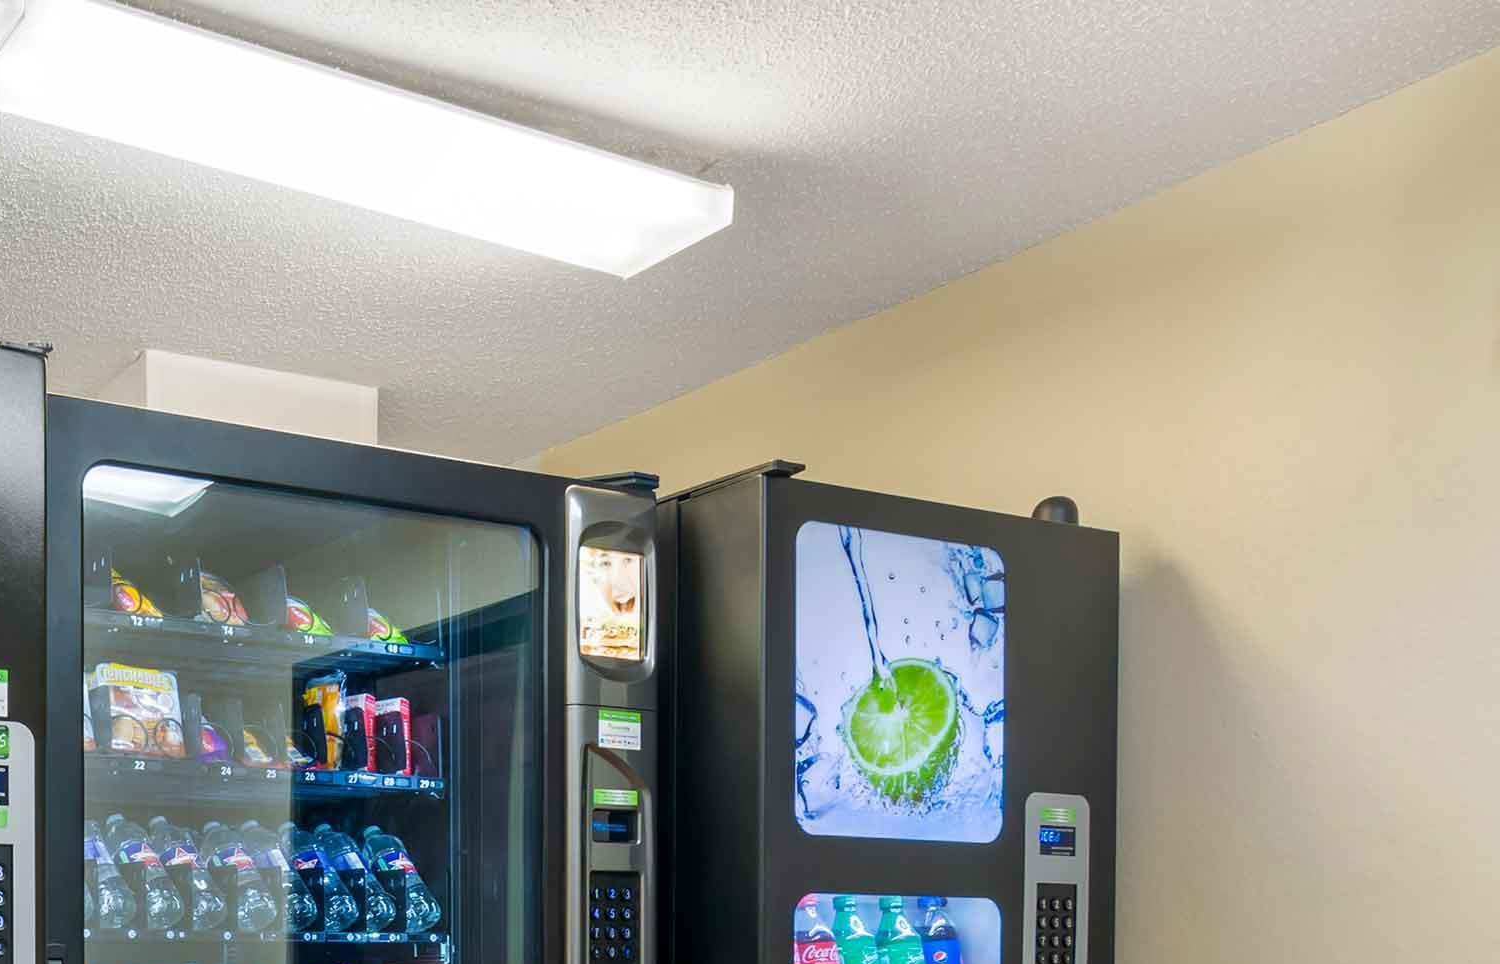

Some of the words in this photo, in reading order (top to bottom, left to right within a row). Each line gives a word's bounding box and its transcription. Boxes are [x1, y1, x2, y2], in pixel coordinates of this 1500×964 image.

[223, 626, 234, 636] 14
[304, 635, 314, 645] 16
[134, 760, 145, 770] 22
[221, 766, 232, 776] 24
[266, 769, 277, 778] 25
[304, 772, 316, 782] 26
